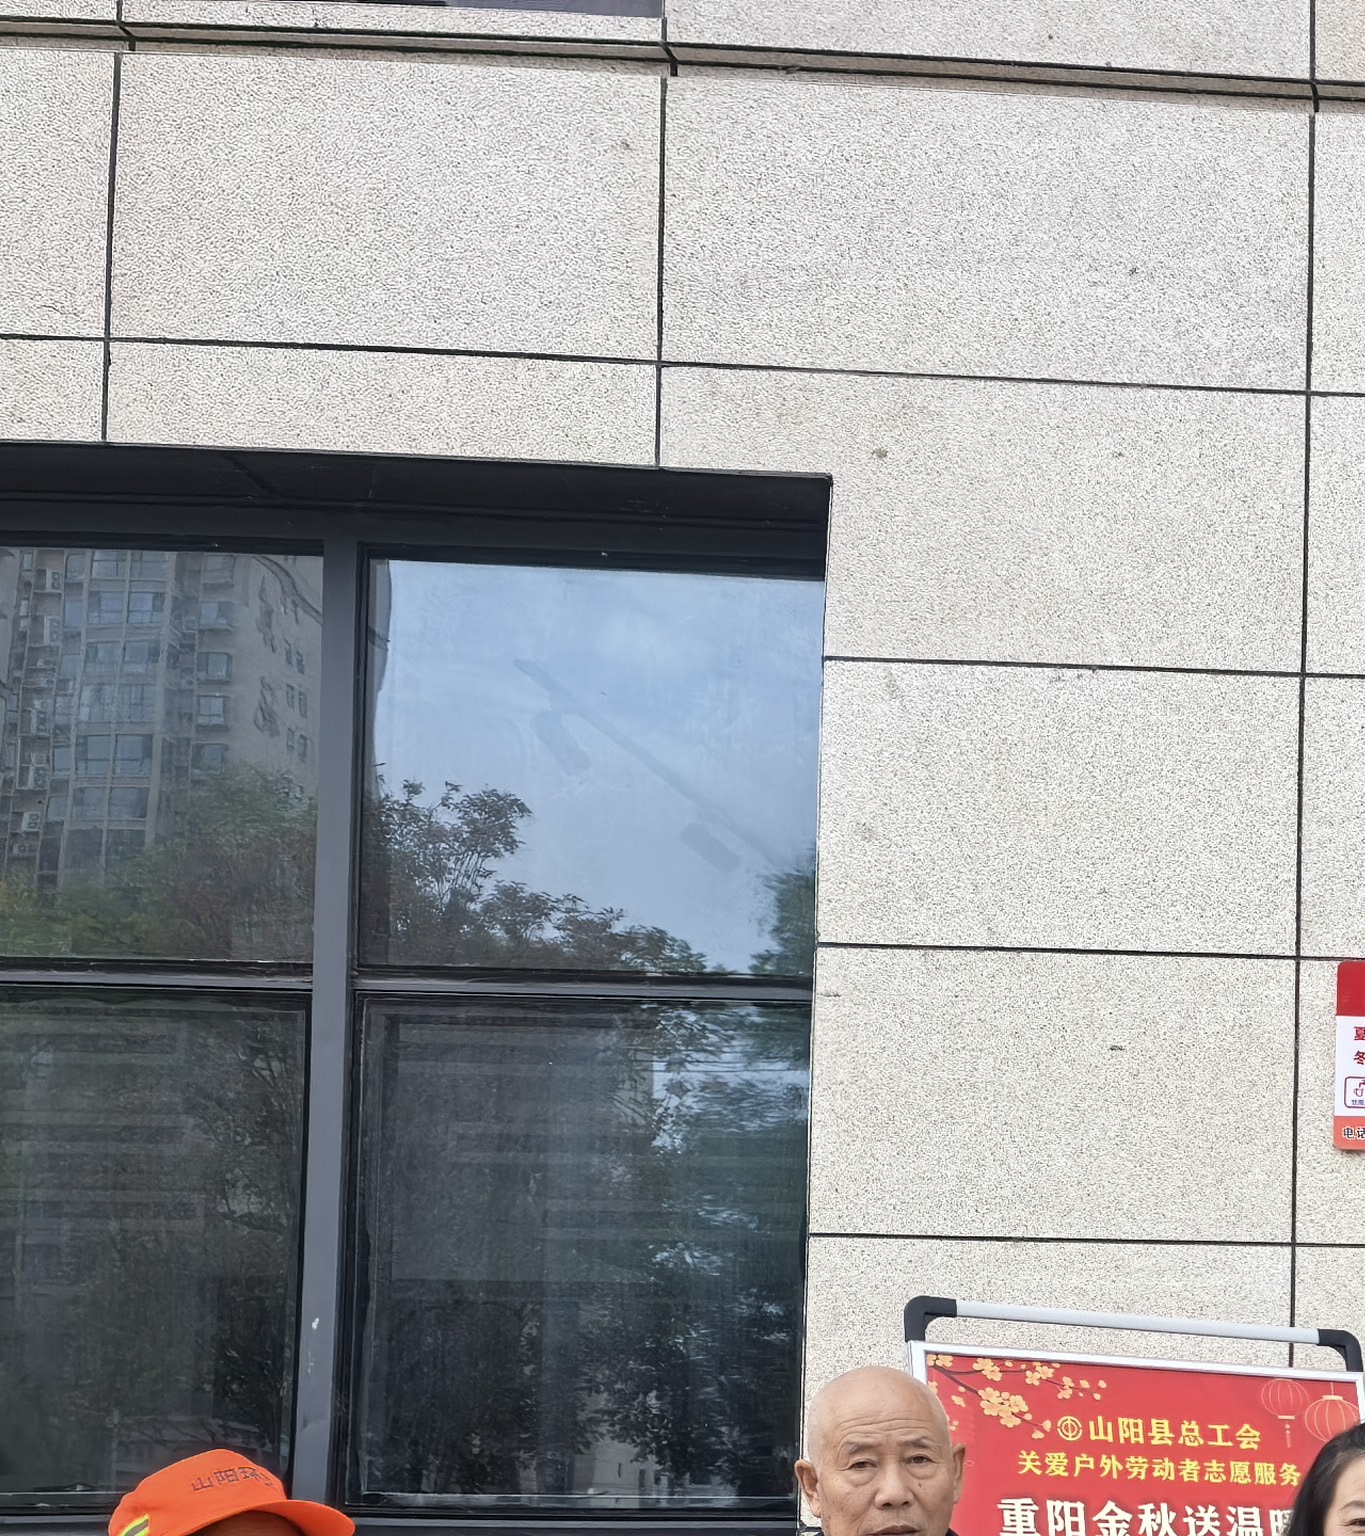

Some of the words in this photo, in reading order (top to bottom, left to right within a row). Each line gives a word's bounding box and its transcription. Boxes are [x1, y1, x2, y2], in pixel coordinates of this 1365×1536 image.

[1088, 1415, 1261, 1451] 山阳县总工会
[1018, 1450, 1301, 1487] 关爱户外劳动者志愿服务
